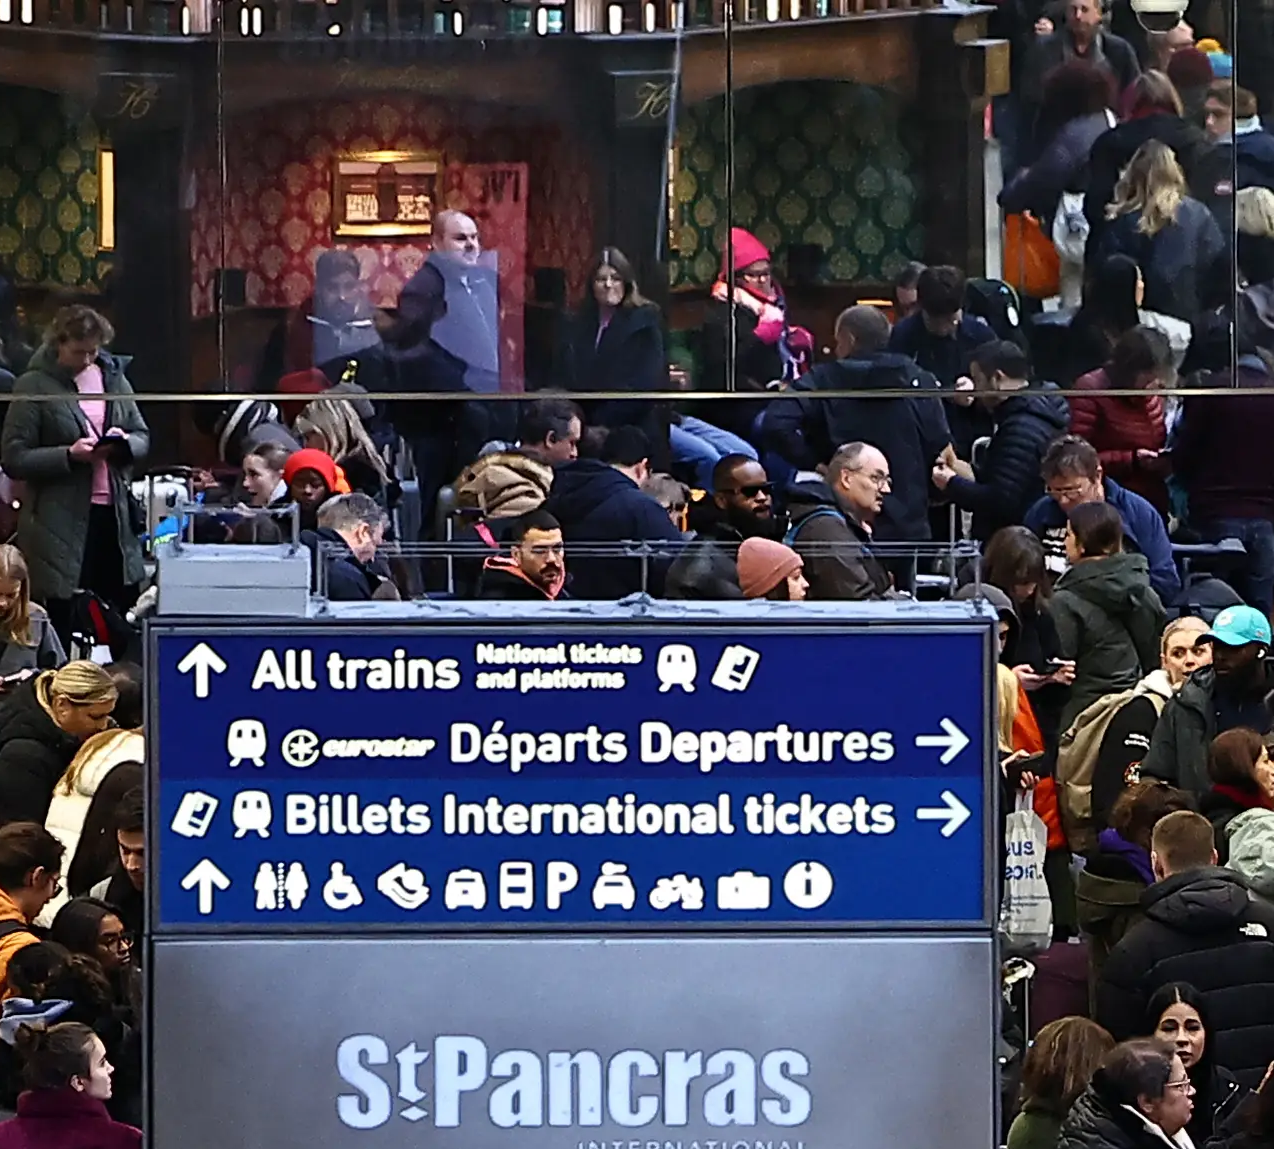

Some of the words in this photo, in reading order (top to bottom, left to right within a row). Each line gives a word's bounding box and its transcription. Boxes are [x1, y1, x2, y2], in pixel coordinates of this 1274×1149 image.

[251, 649, 317, 690] All
[326, 648, 461, 690] trains
[475, 642, 566, 667] National
[569, 642, 643, 666] tickets
[475, 668, 517, 693] and
[519, 667, 626, 694] platforms
[321, 736, 436, 759] eurostar
[450, 720, 628, 773] Départs
[640, 721, 894, 773] Departures
[286, 794, 431, 835] Billets
[444, 793, 735, 835] International
[743, 792, 896, 835] tickets
